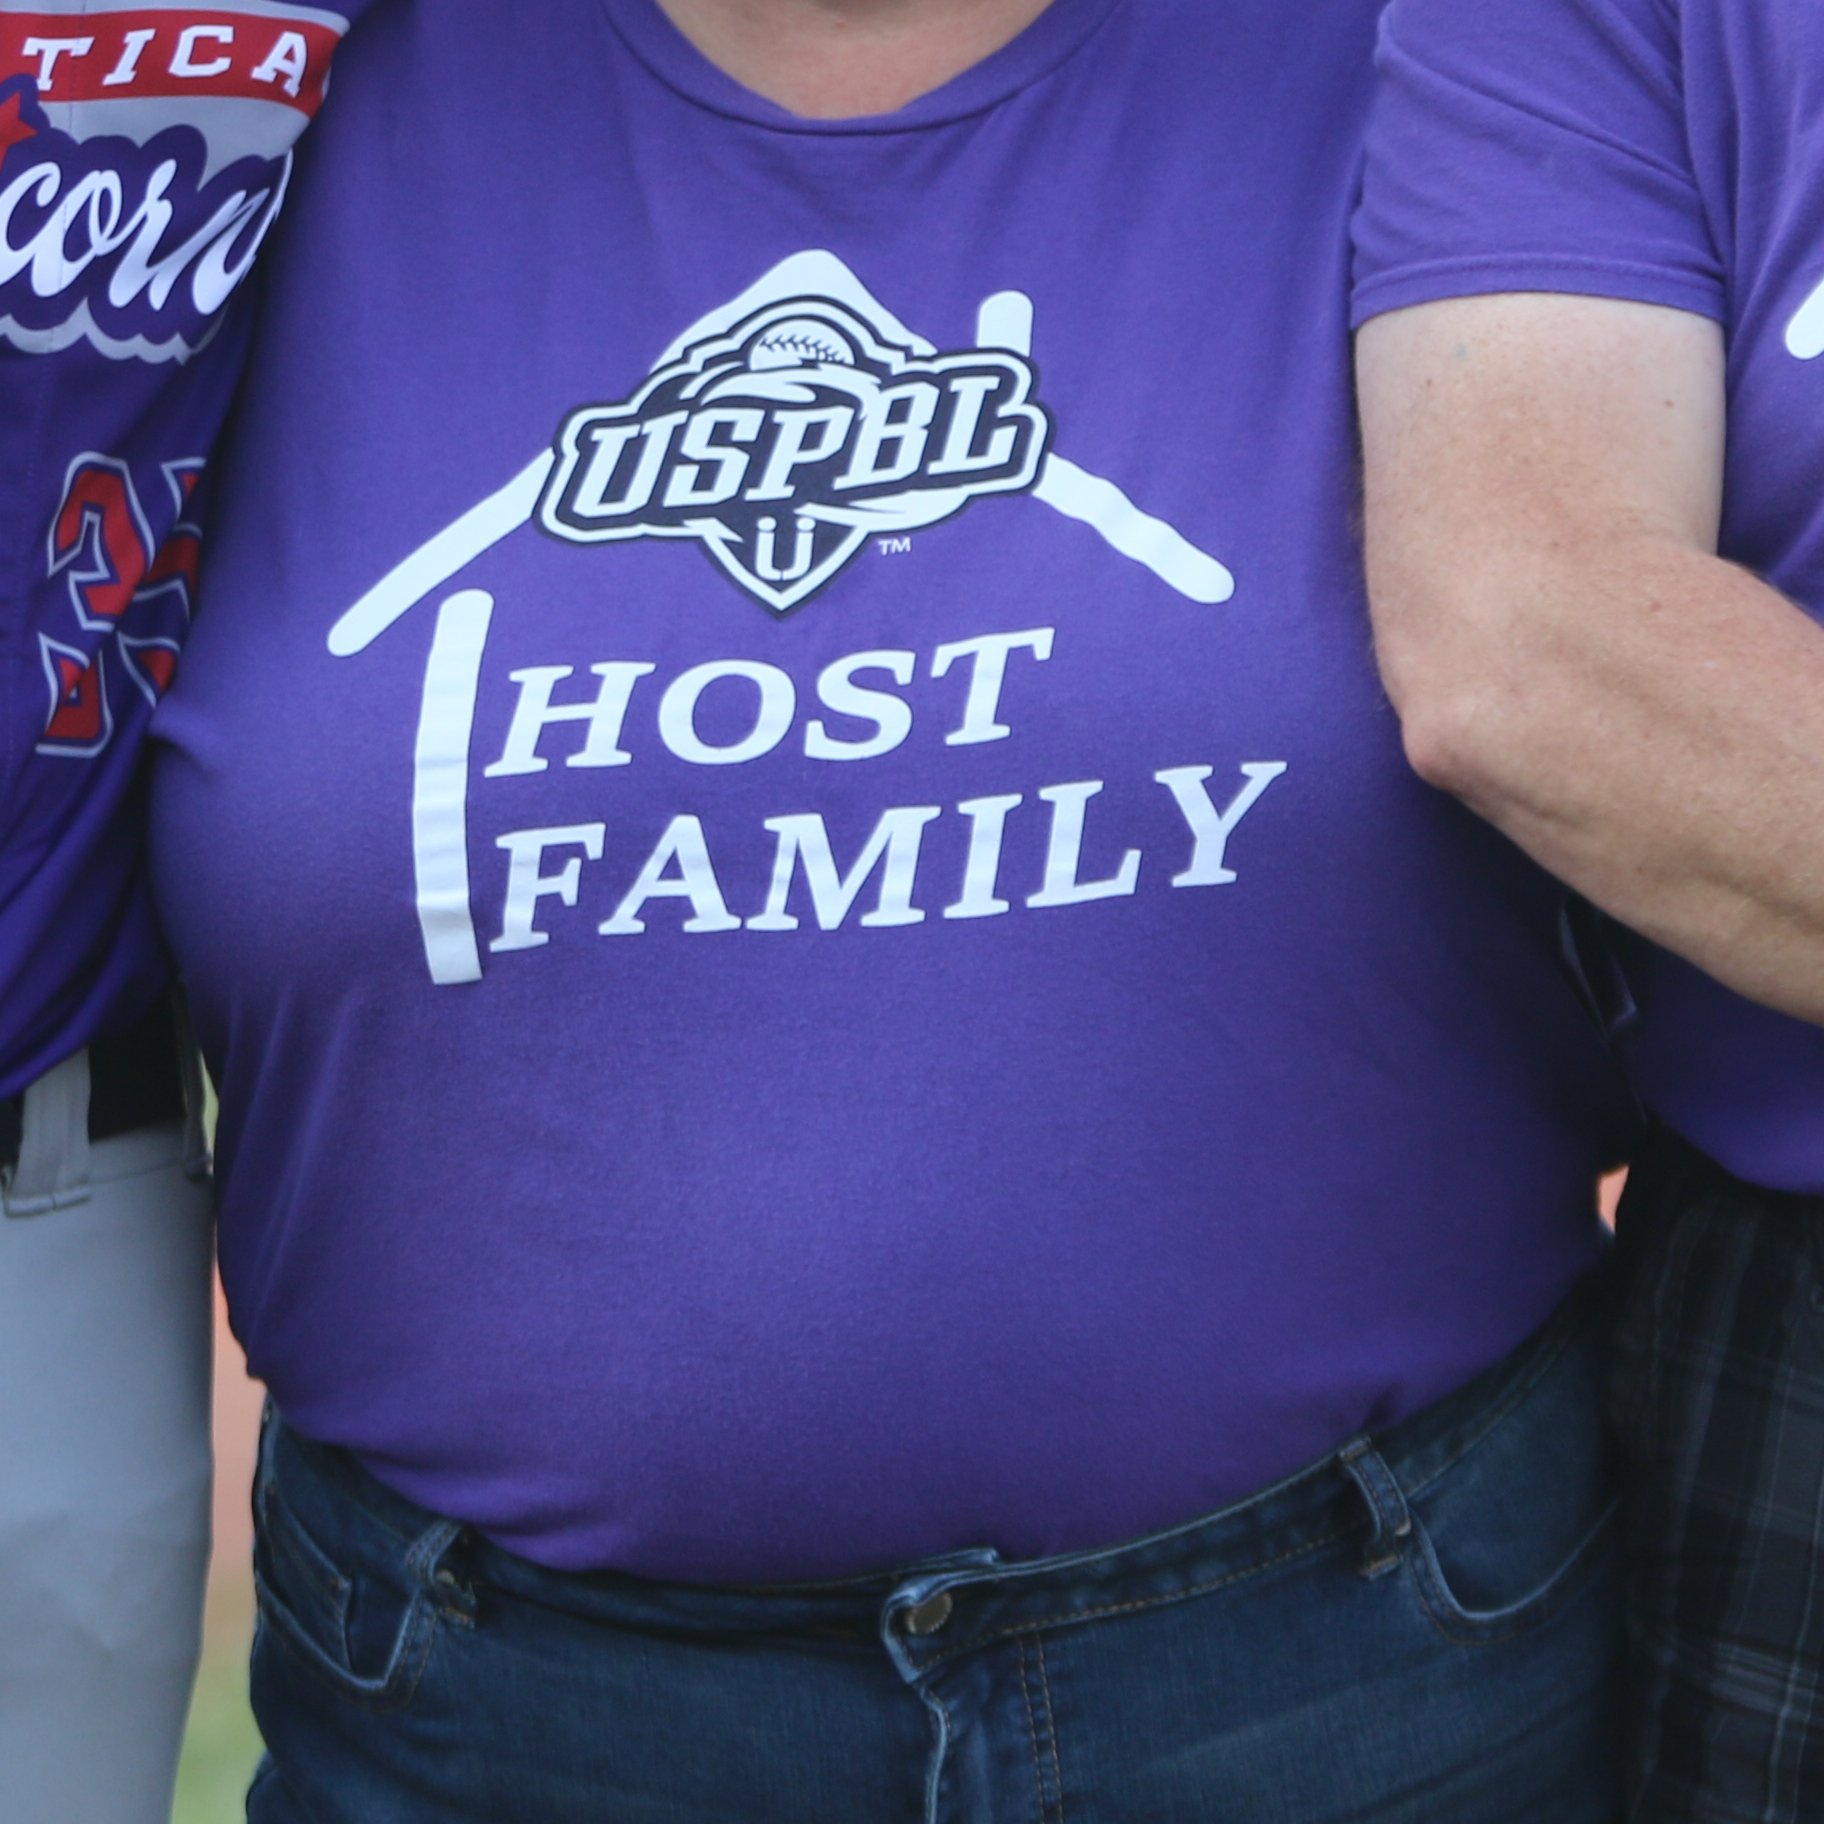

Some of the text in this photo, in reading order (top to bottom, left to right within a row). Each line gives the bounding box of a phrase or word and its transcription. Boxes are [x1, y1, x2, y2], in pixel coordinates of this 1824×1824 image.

[572, 375, 1024, 516] USPBL
[484, 627, 1054, 776] HOST
[490, 762, 1287, 952] FAMILY
